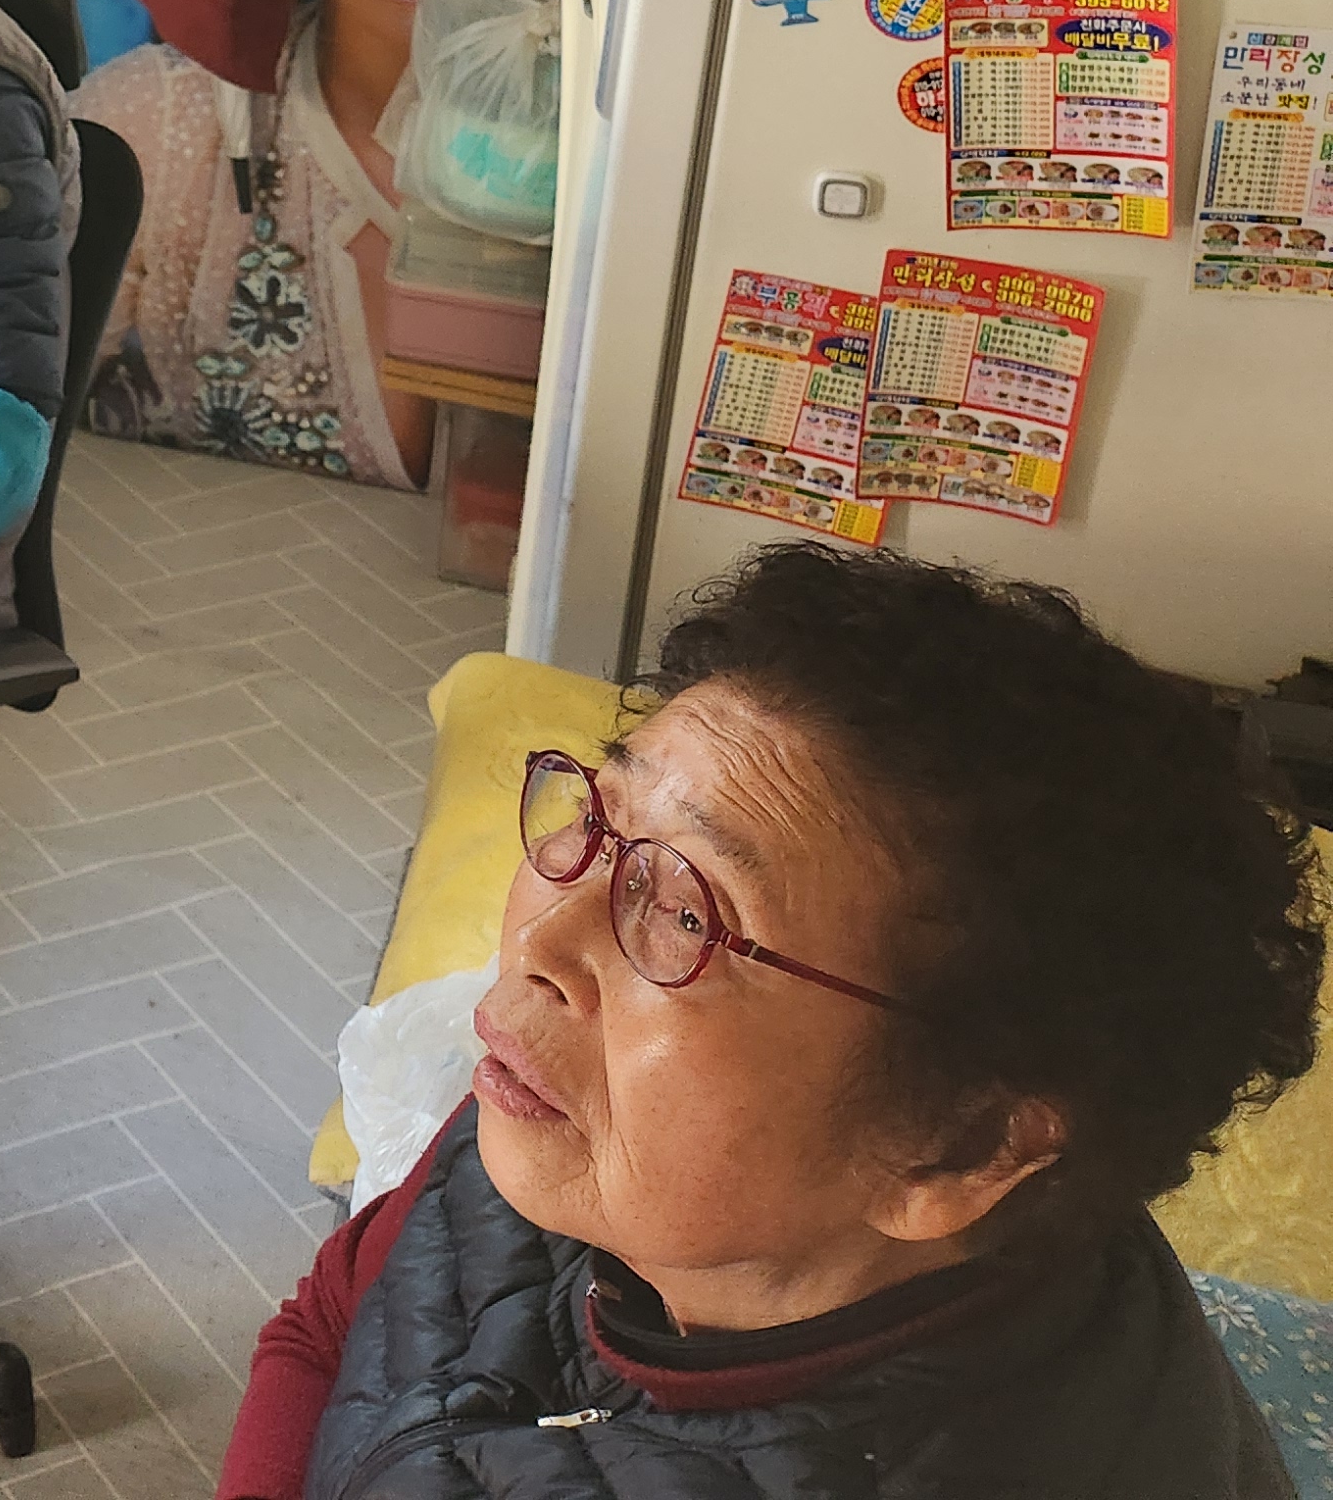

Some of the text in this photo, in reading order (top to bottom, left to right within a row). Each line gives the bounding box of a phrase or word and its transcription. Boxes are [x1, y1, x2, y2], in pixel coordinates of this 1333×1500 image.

[1222, 46, 1327, 76] 만리장성
[1221, 91, 1270, 107] 소문난
[893, 266, 976, 294] 만리장성
